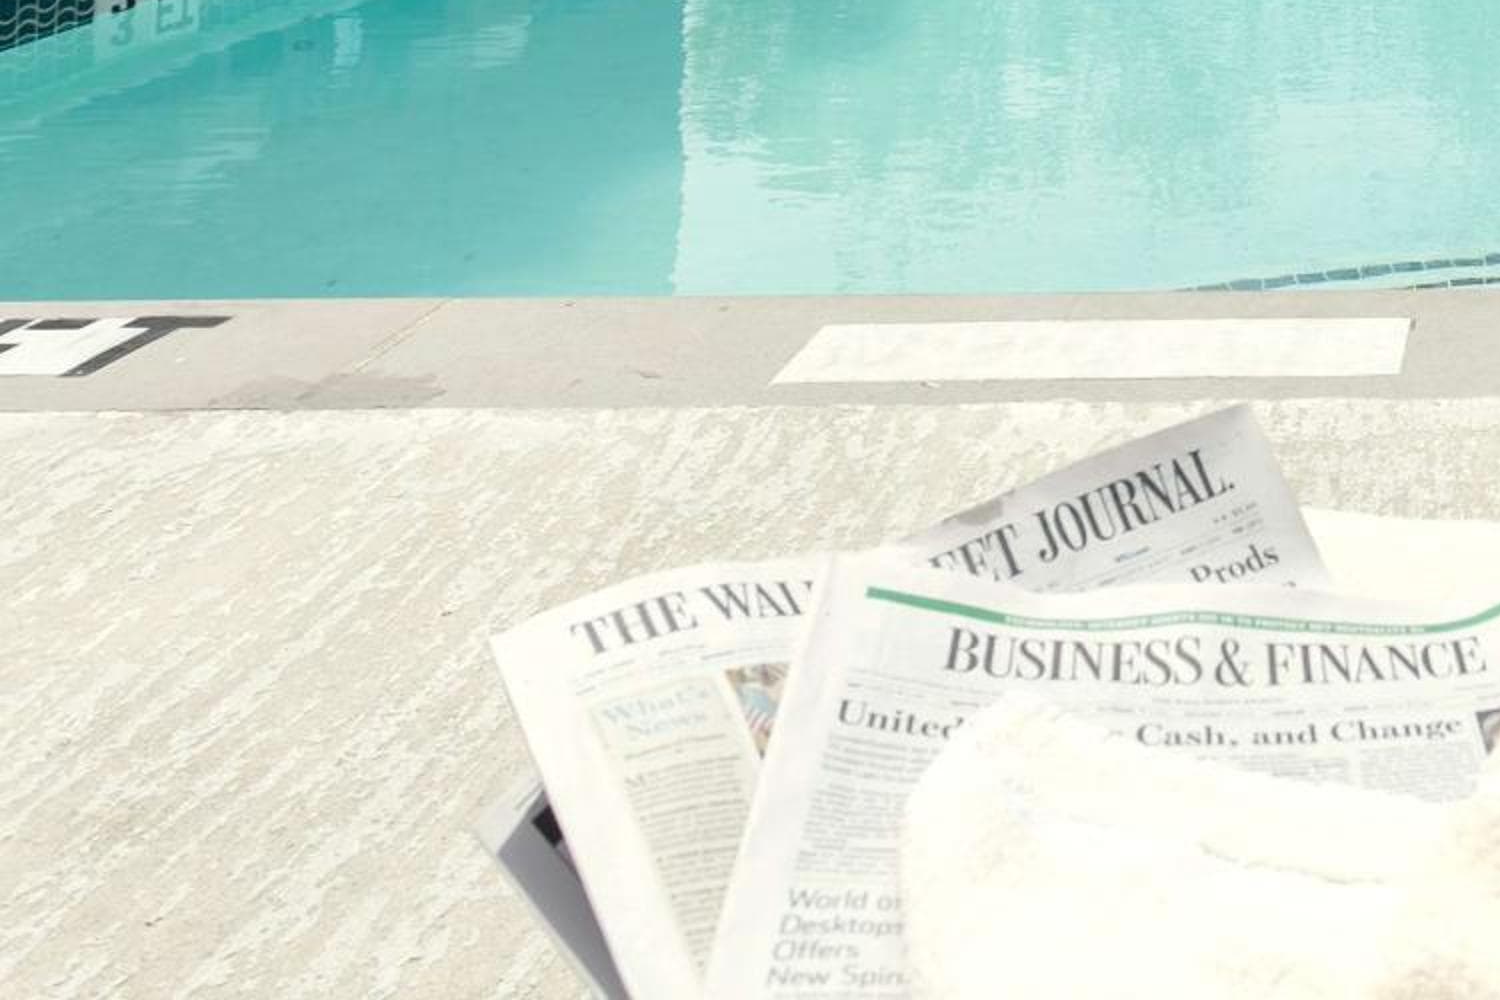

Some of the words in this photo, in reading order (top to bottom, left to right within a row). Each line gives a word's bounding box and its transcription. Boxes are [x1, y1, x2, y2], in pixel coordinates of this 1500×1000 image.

[1033, 448, 1235, 562] JOURNAL.
[570, 591, 698, 654] THE
[943, 627, 1204, 686] BUSINESS
[1214, 637, 1252, 688] &
[1264, 636, 1487, 687] FINANCE
[1252, 723, 1318, 745] and
[1330, 719, 1462, 743] Change
[787, 888, 868, 909] World
[772, 940, 860, 962] Offers
[766, 966, 830, 988] New
